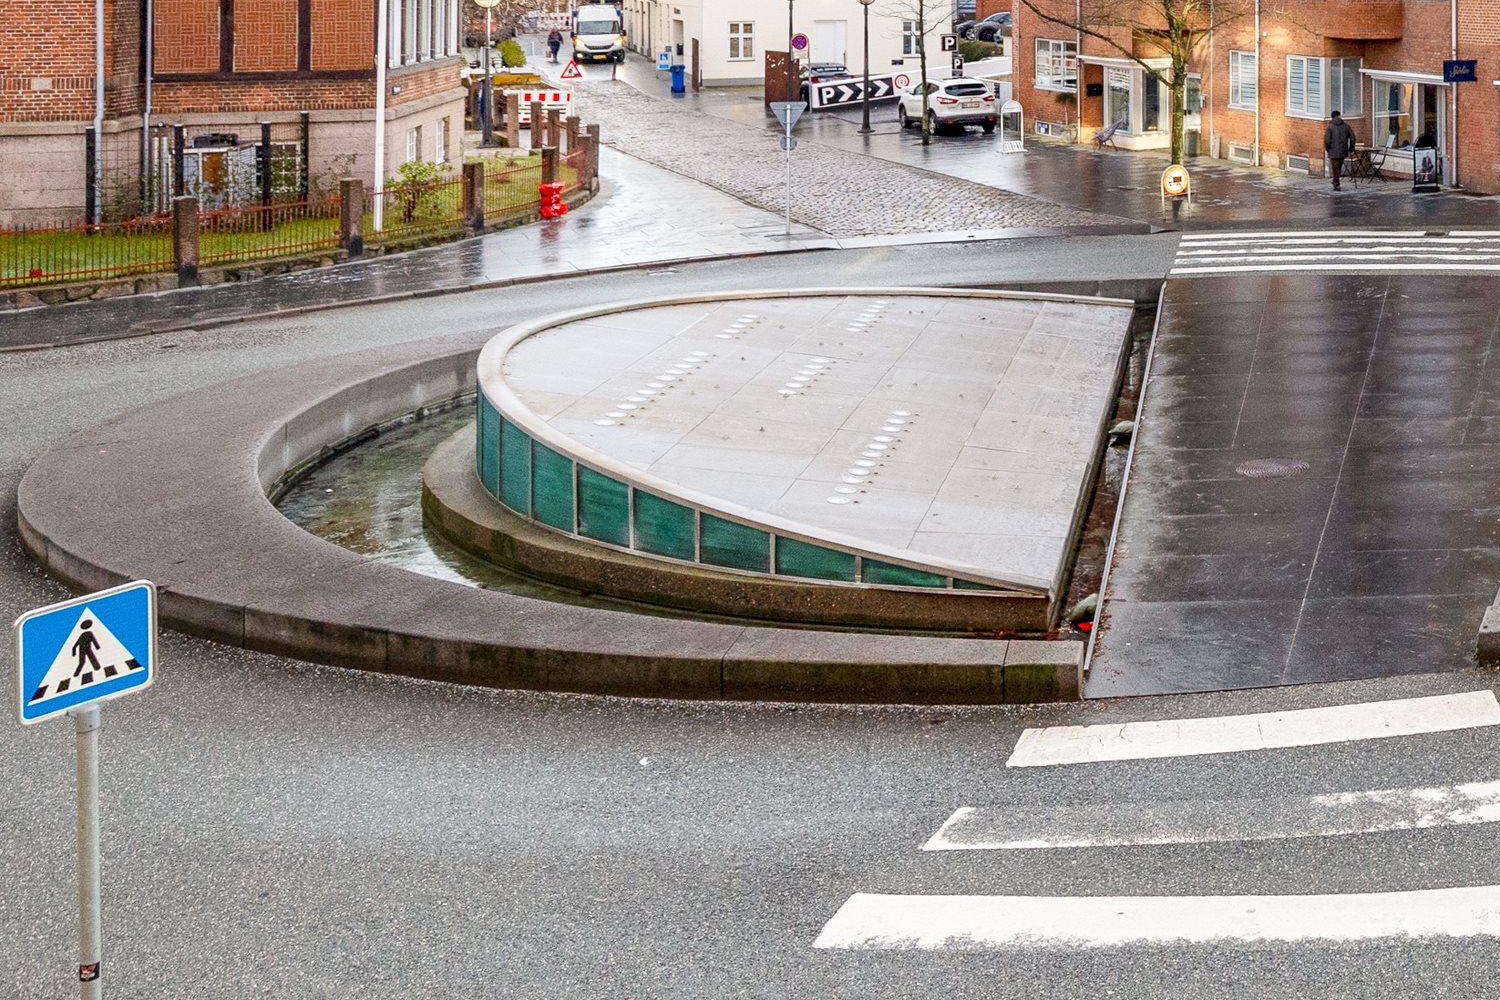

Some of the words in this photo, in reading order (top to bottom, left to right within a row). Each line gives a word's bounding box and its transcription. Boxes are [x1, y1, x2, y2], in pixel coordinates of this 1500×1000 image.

[945, 37, 954, 50] P
[954, 59, 960, 69] P
[822, 87, 834, 104] P
